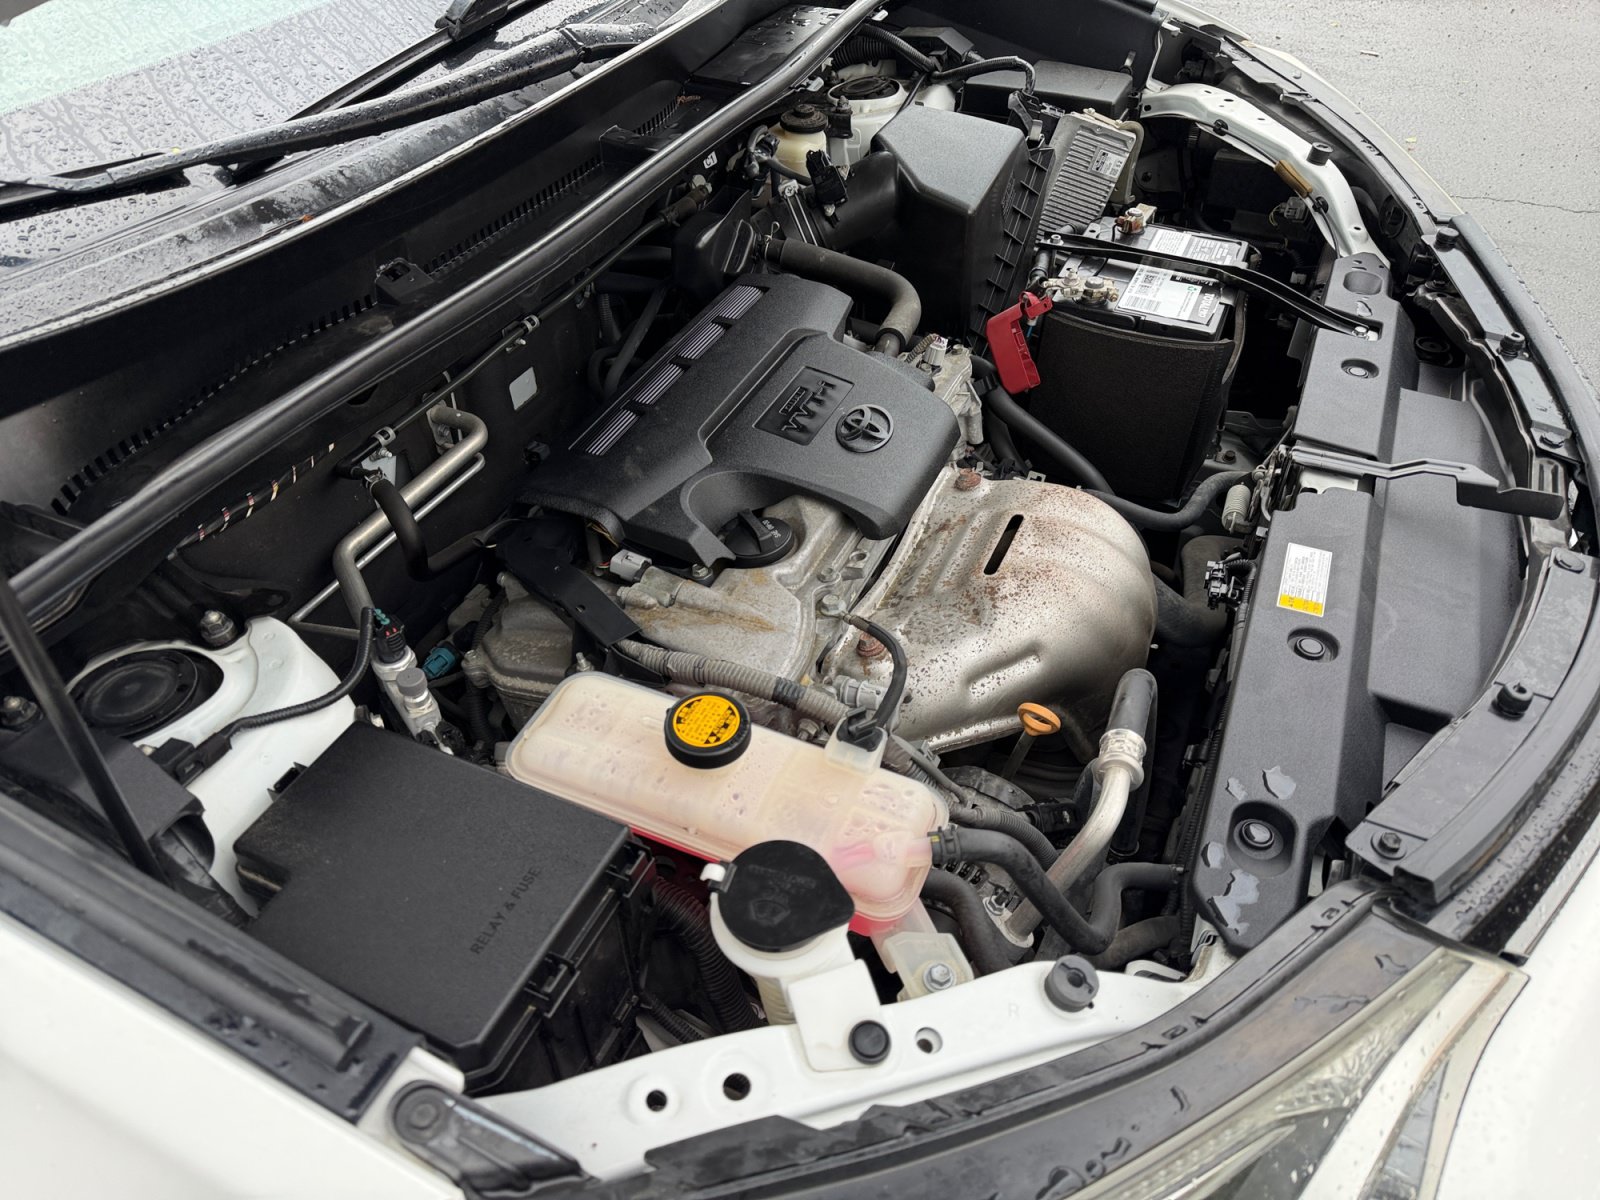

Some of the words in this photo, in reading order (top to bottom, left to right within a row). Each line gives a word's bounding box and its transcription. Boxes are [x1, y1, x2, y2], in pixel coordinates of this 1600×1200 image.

[781, 380, 836, 432] VVT-i
[470, 911, 505, 954] RELAY
[504, 901, 516, 911] &
[511, 867, 541, 900] FUSE
